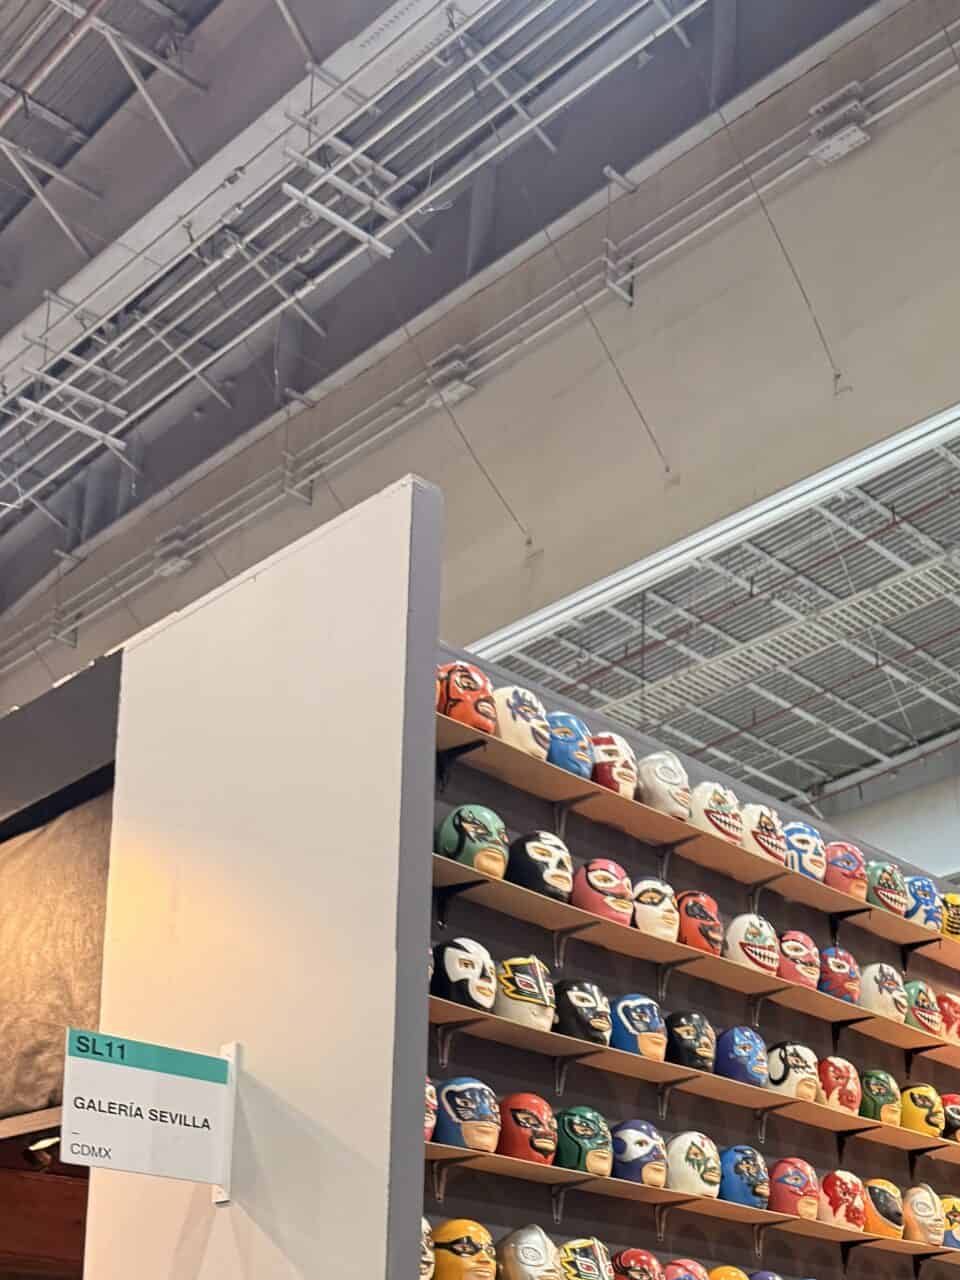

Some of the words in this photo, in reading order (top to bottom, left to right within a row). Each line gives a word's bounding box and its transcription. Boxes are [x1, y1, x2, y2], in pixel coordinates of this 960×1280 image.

[75, 1035, 126, 1060] SL11
[73, 1096, 144, 1120] GALERÍA
[148, 1108, 211, 1131] SEVILLA
[70, 1143, 112, 1160] CDMX
